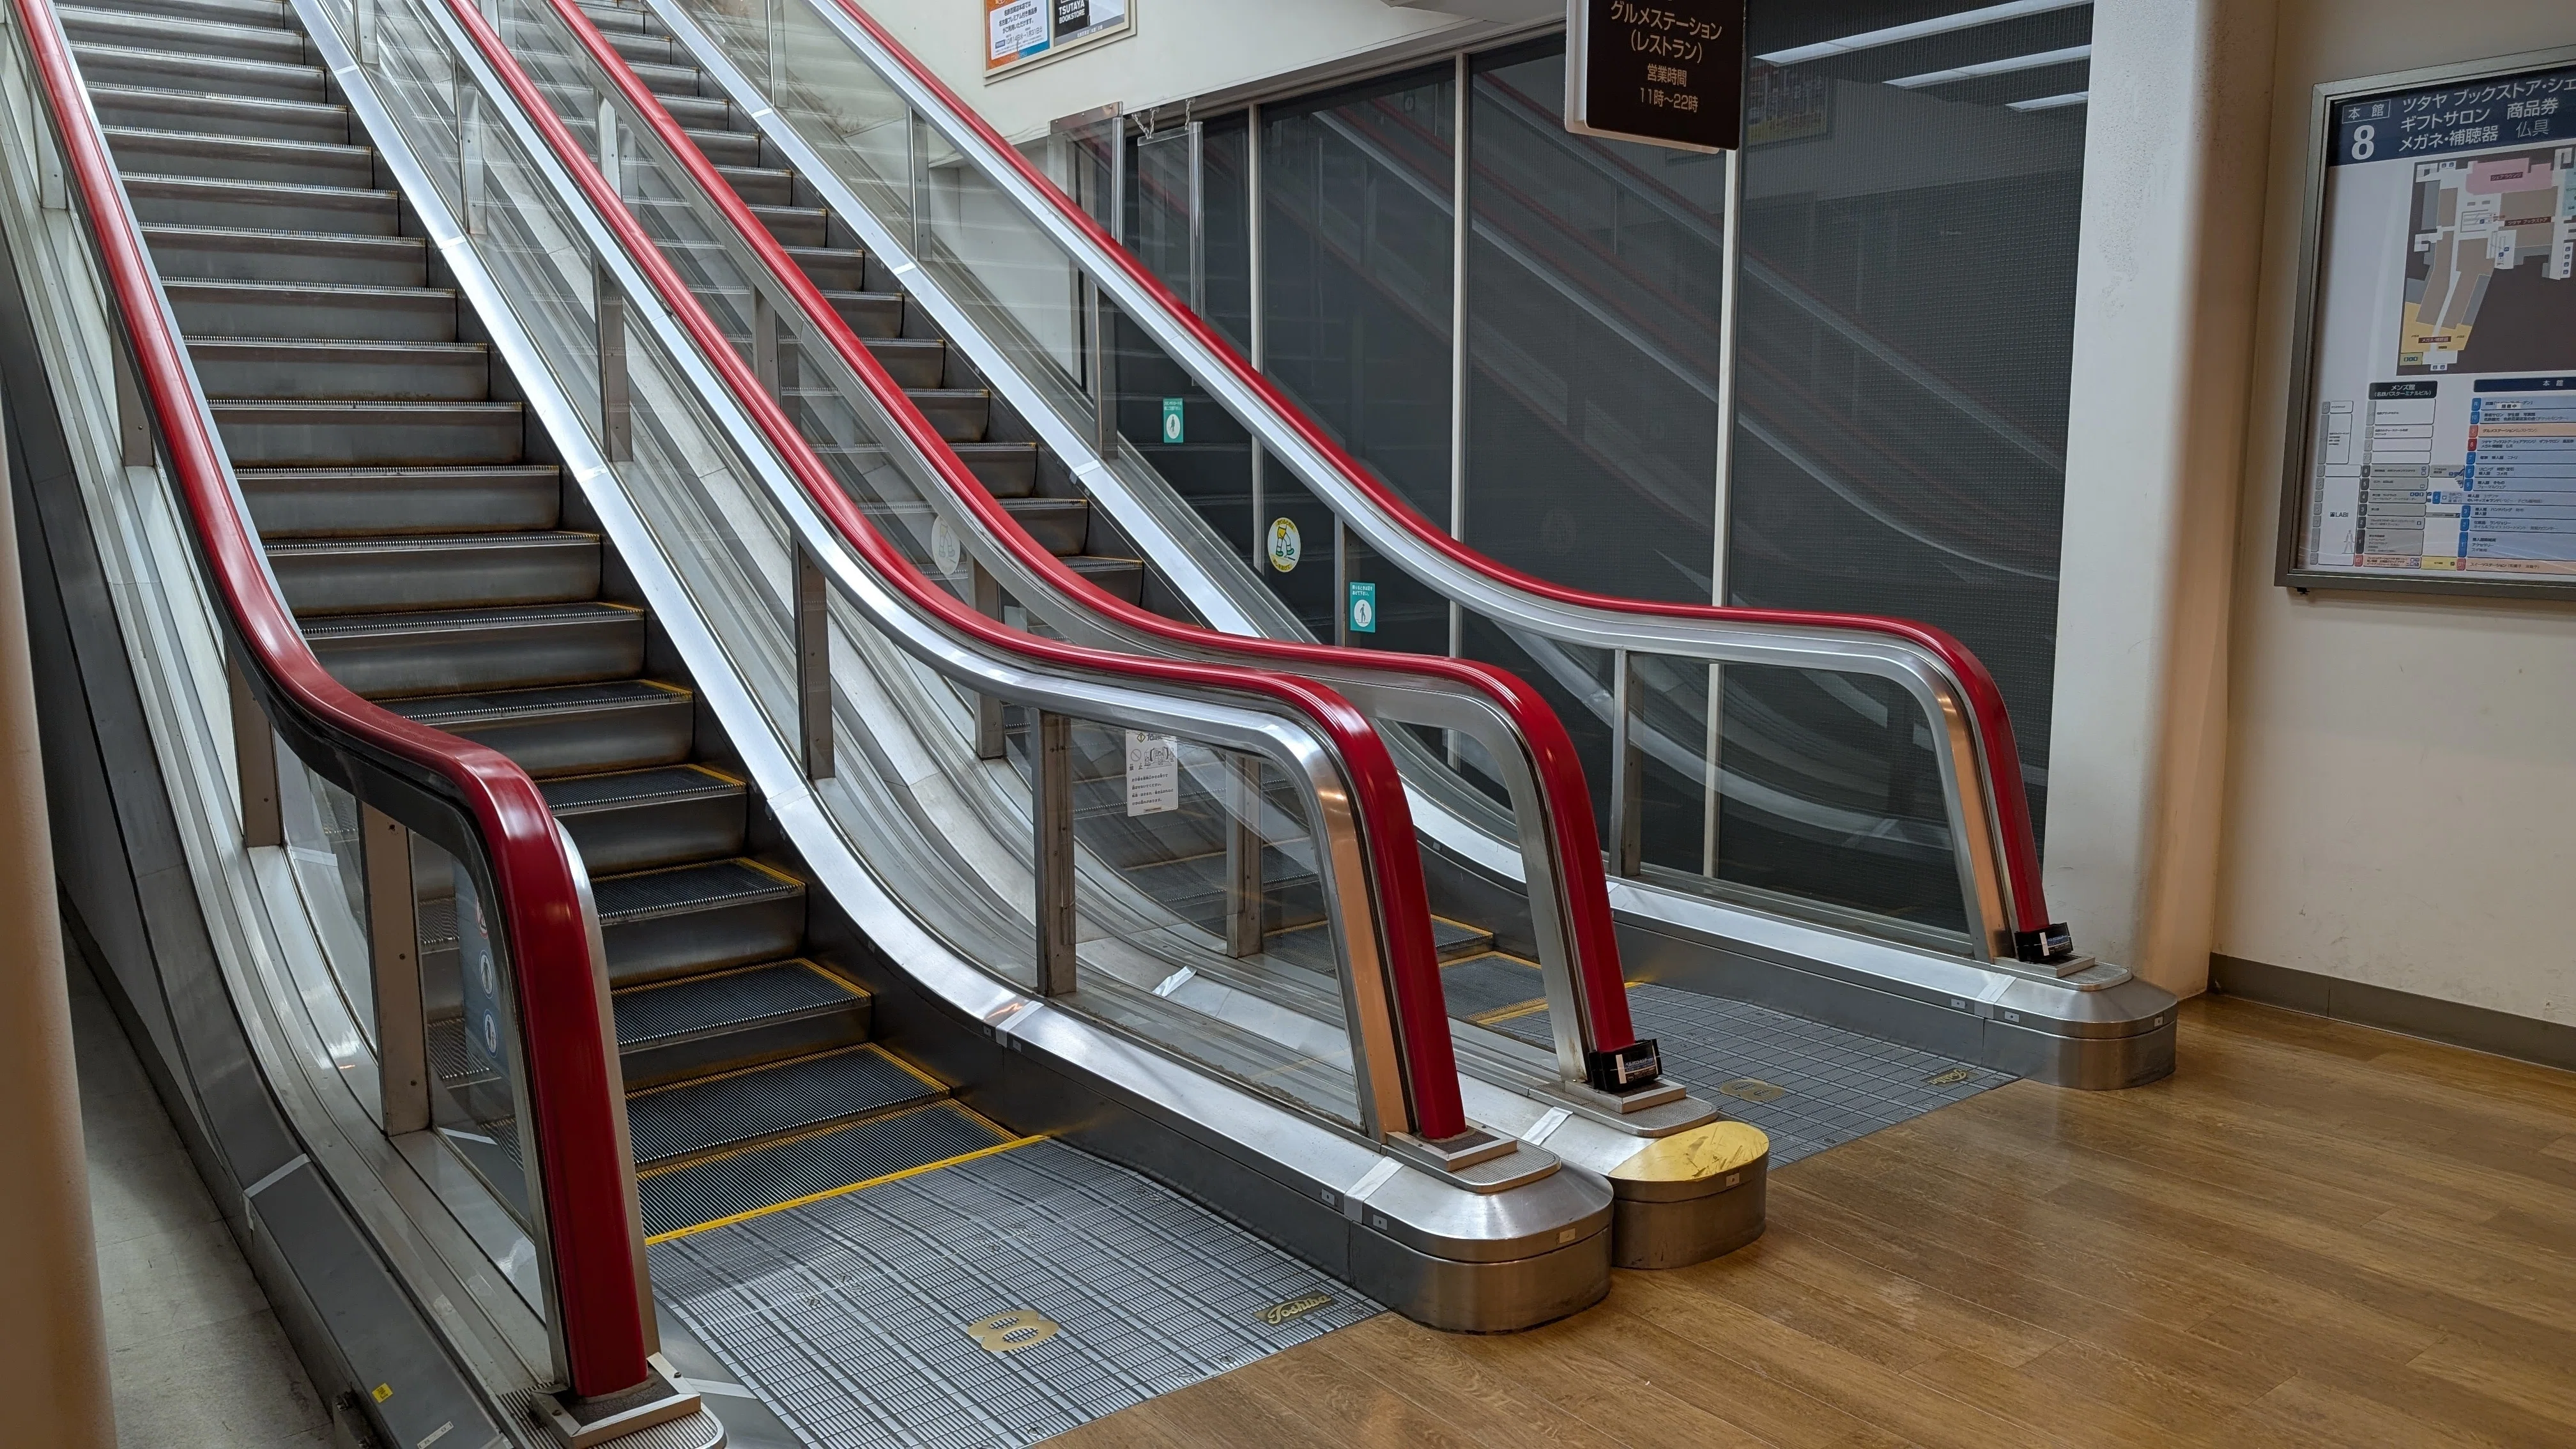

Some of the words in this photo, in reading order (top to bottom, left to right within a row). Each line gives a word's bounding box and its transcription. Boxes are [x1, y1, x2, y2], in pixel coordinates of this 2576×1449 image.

[1059, 1, 1085, 16] TSUTAYA
[1059, 8, 1085, 24] BOOKSTORE
[1611, 0, 1722, 40] グルメステーション
[1630, 29, 1703, 64] (レストラン)
[1647, 63, 1687, 87] 営業時間
[2348, 104, 2384, 119] 本館
[2400, 109, 2490, 132] ギフトサロン
[2506, 98, 2559, 119] 商品券
[2402, 95, 2447, 113] ツタヤ
[2351, 125, 2375, 160] 8
[2398, 125, 2499, 152] メガネ・補聴器
[2516, 119, 2549, 138] 仏具
[1267, 1295, 1332, 1324] Toshiba
[967, 1309, 1060, 1352] 8
